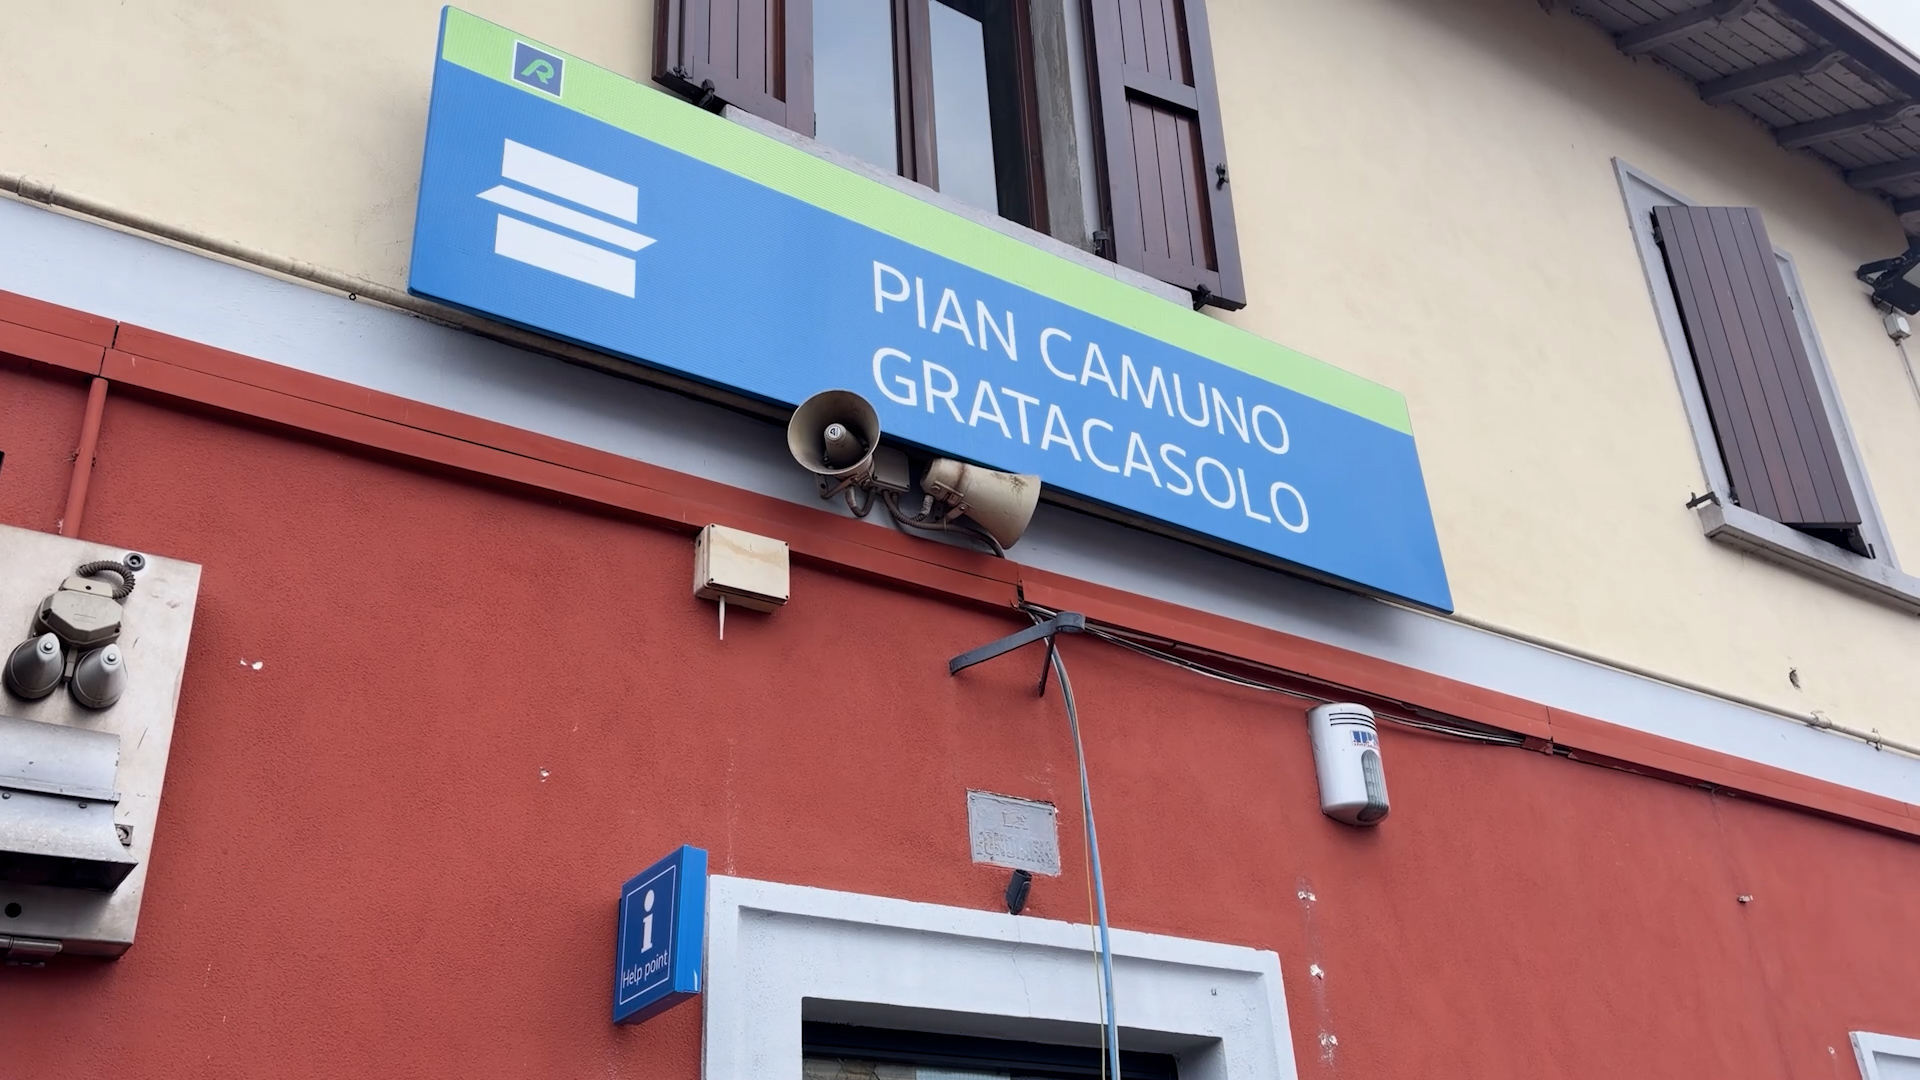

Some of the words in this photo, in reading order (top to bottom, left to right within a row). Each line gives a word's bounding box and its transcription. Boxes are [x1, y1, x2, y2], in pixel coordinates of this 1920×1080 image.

[871, 346, 1309, 534] GRATACASOLO
[872, 260, 1018, 362] PIAN
[1039, 327, 1290, 455] CAMUNO
[622, 964, 643, 988] Help
[644, 950, 668, 980] point
